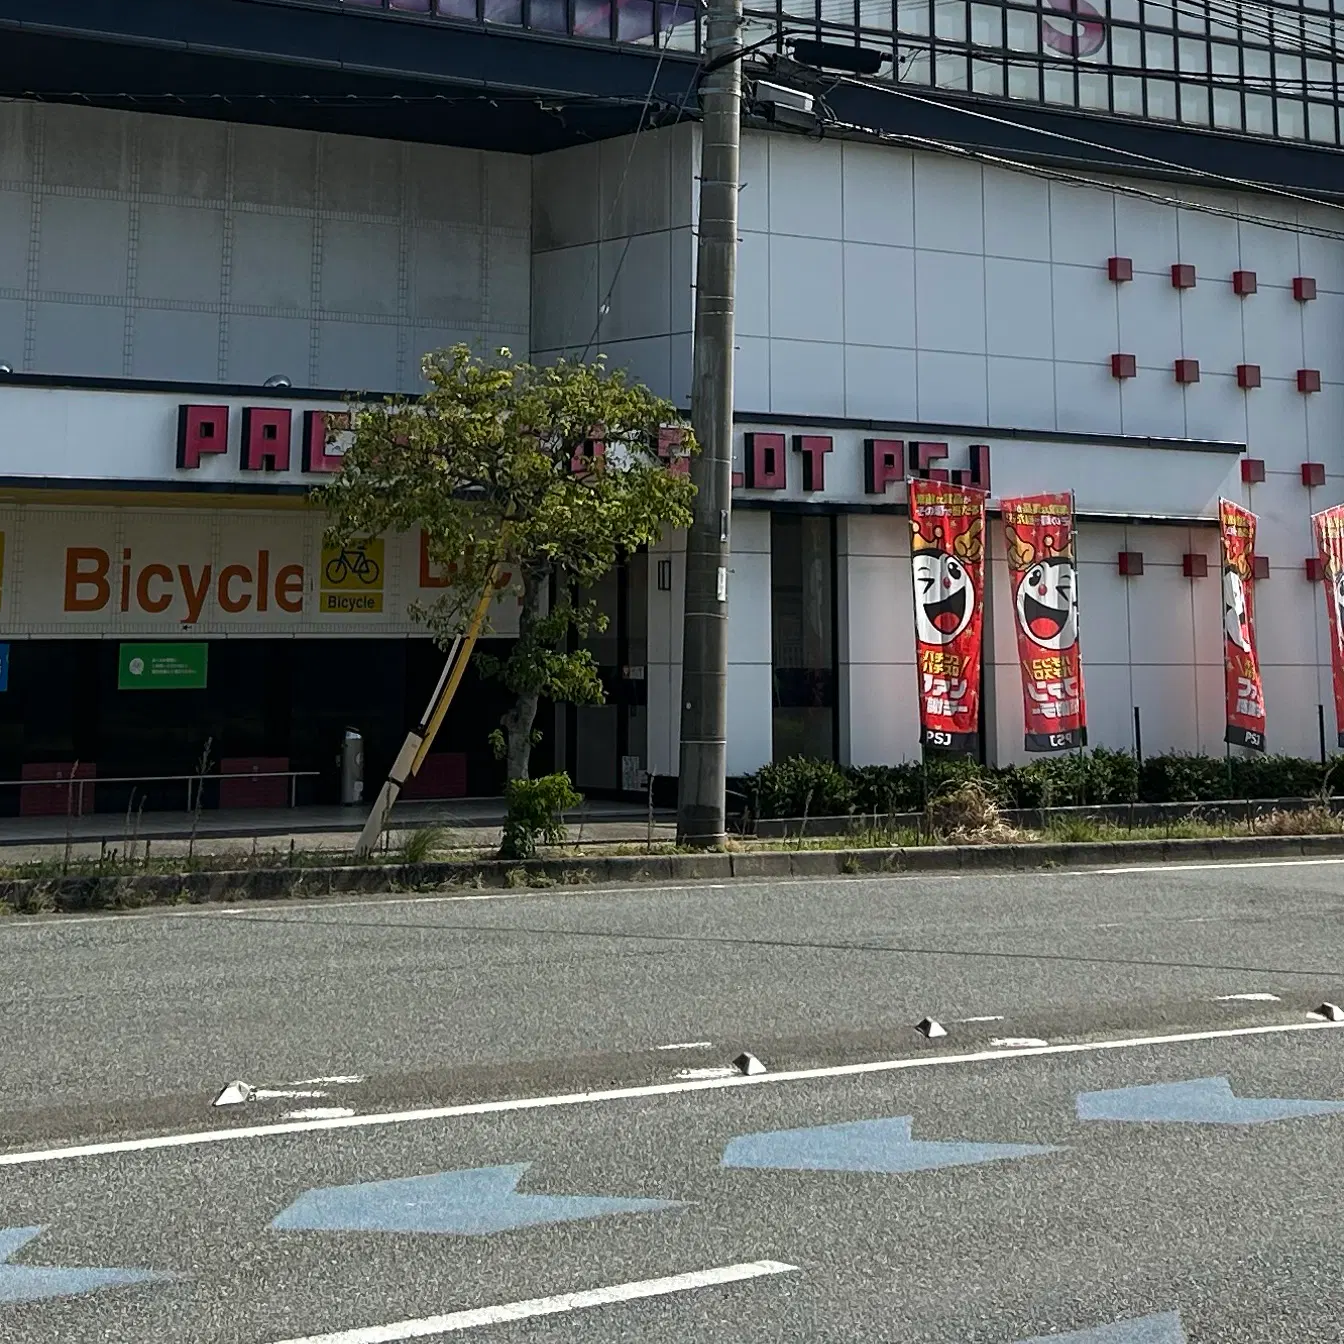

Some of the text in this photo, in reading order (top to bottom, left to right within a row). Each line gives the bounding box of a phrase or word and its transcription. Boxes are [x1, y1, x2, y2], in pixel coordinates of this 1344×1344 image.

[863, 439, 990, 498] PSJ
[64, 547, 304, 624] Bicycle
[327, 595, 375, 612] Bicycle
[926, 731, 952, 746] PSJ
[1244, 730, 1261, 746] PSJ
